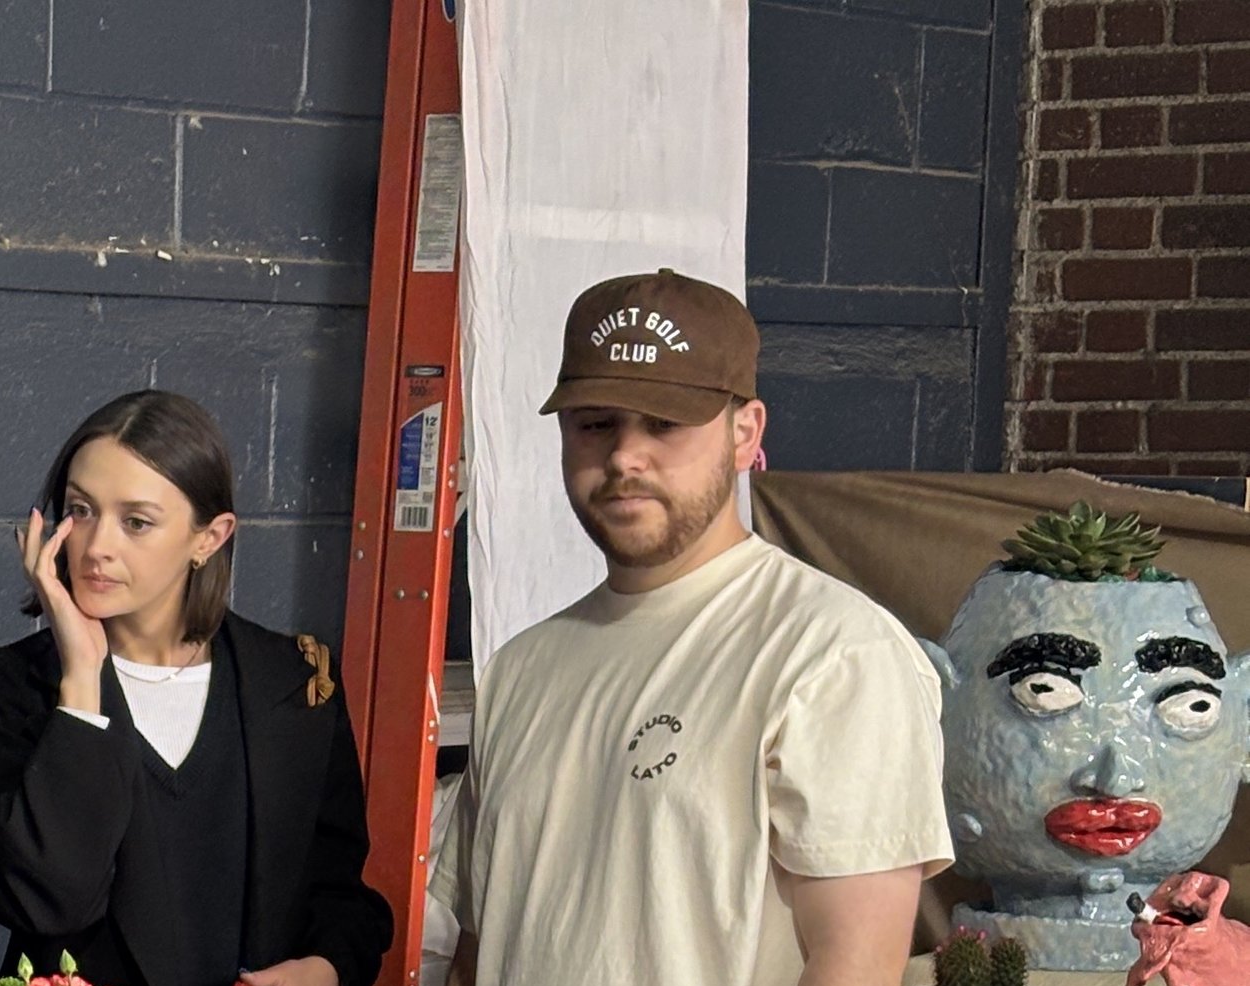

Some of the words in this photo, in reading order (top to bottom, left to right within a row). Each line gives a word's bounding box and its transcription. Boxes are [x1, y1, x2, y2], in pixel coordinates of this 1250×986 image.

[590, 307, 640, 347] QUIET
[645, 311, 690, 353] GOLF
[610, 343, 657, 363] CLUB
[631, 752, 677, 780] LATO
